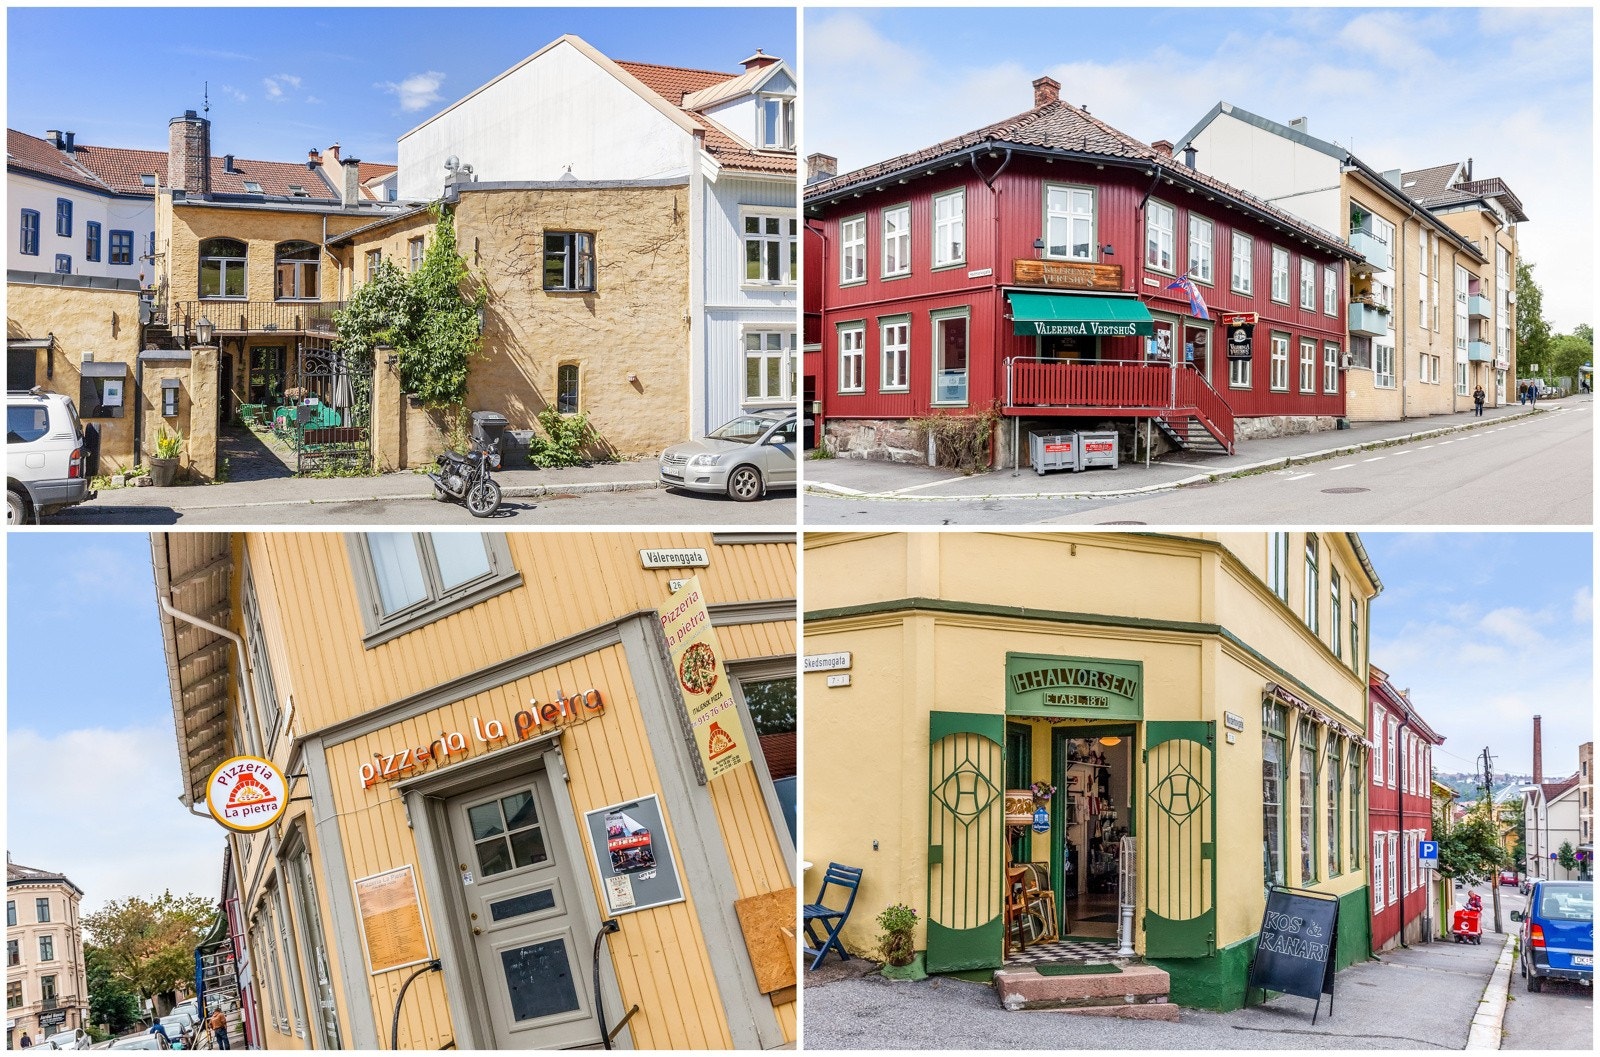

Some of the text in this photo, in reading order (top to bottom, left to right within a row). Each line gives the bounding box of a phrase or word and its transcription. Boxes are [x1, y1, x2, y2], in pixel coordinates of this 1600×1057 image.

[1090, 322, 1136, 335] VERTSHUS
[646, 551, 703, 565] Vålerenggata
[660, 591, 699, 629] Pizzeria
[676, 610, 706, 642] pietra
[804, 656, 846, 668] Skedsmogata
[358, 688, 605, 789] pizzeria la pietra
[217, 763, 273, 786] Pizzeria
[224, 803, 278, 818] La pietra
[1424, 844, 1434, 857] P
[1264, 911, 1303, 933] KOS
[1259, 932, 1328, 962] KANARI
